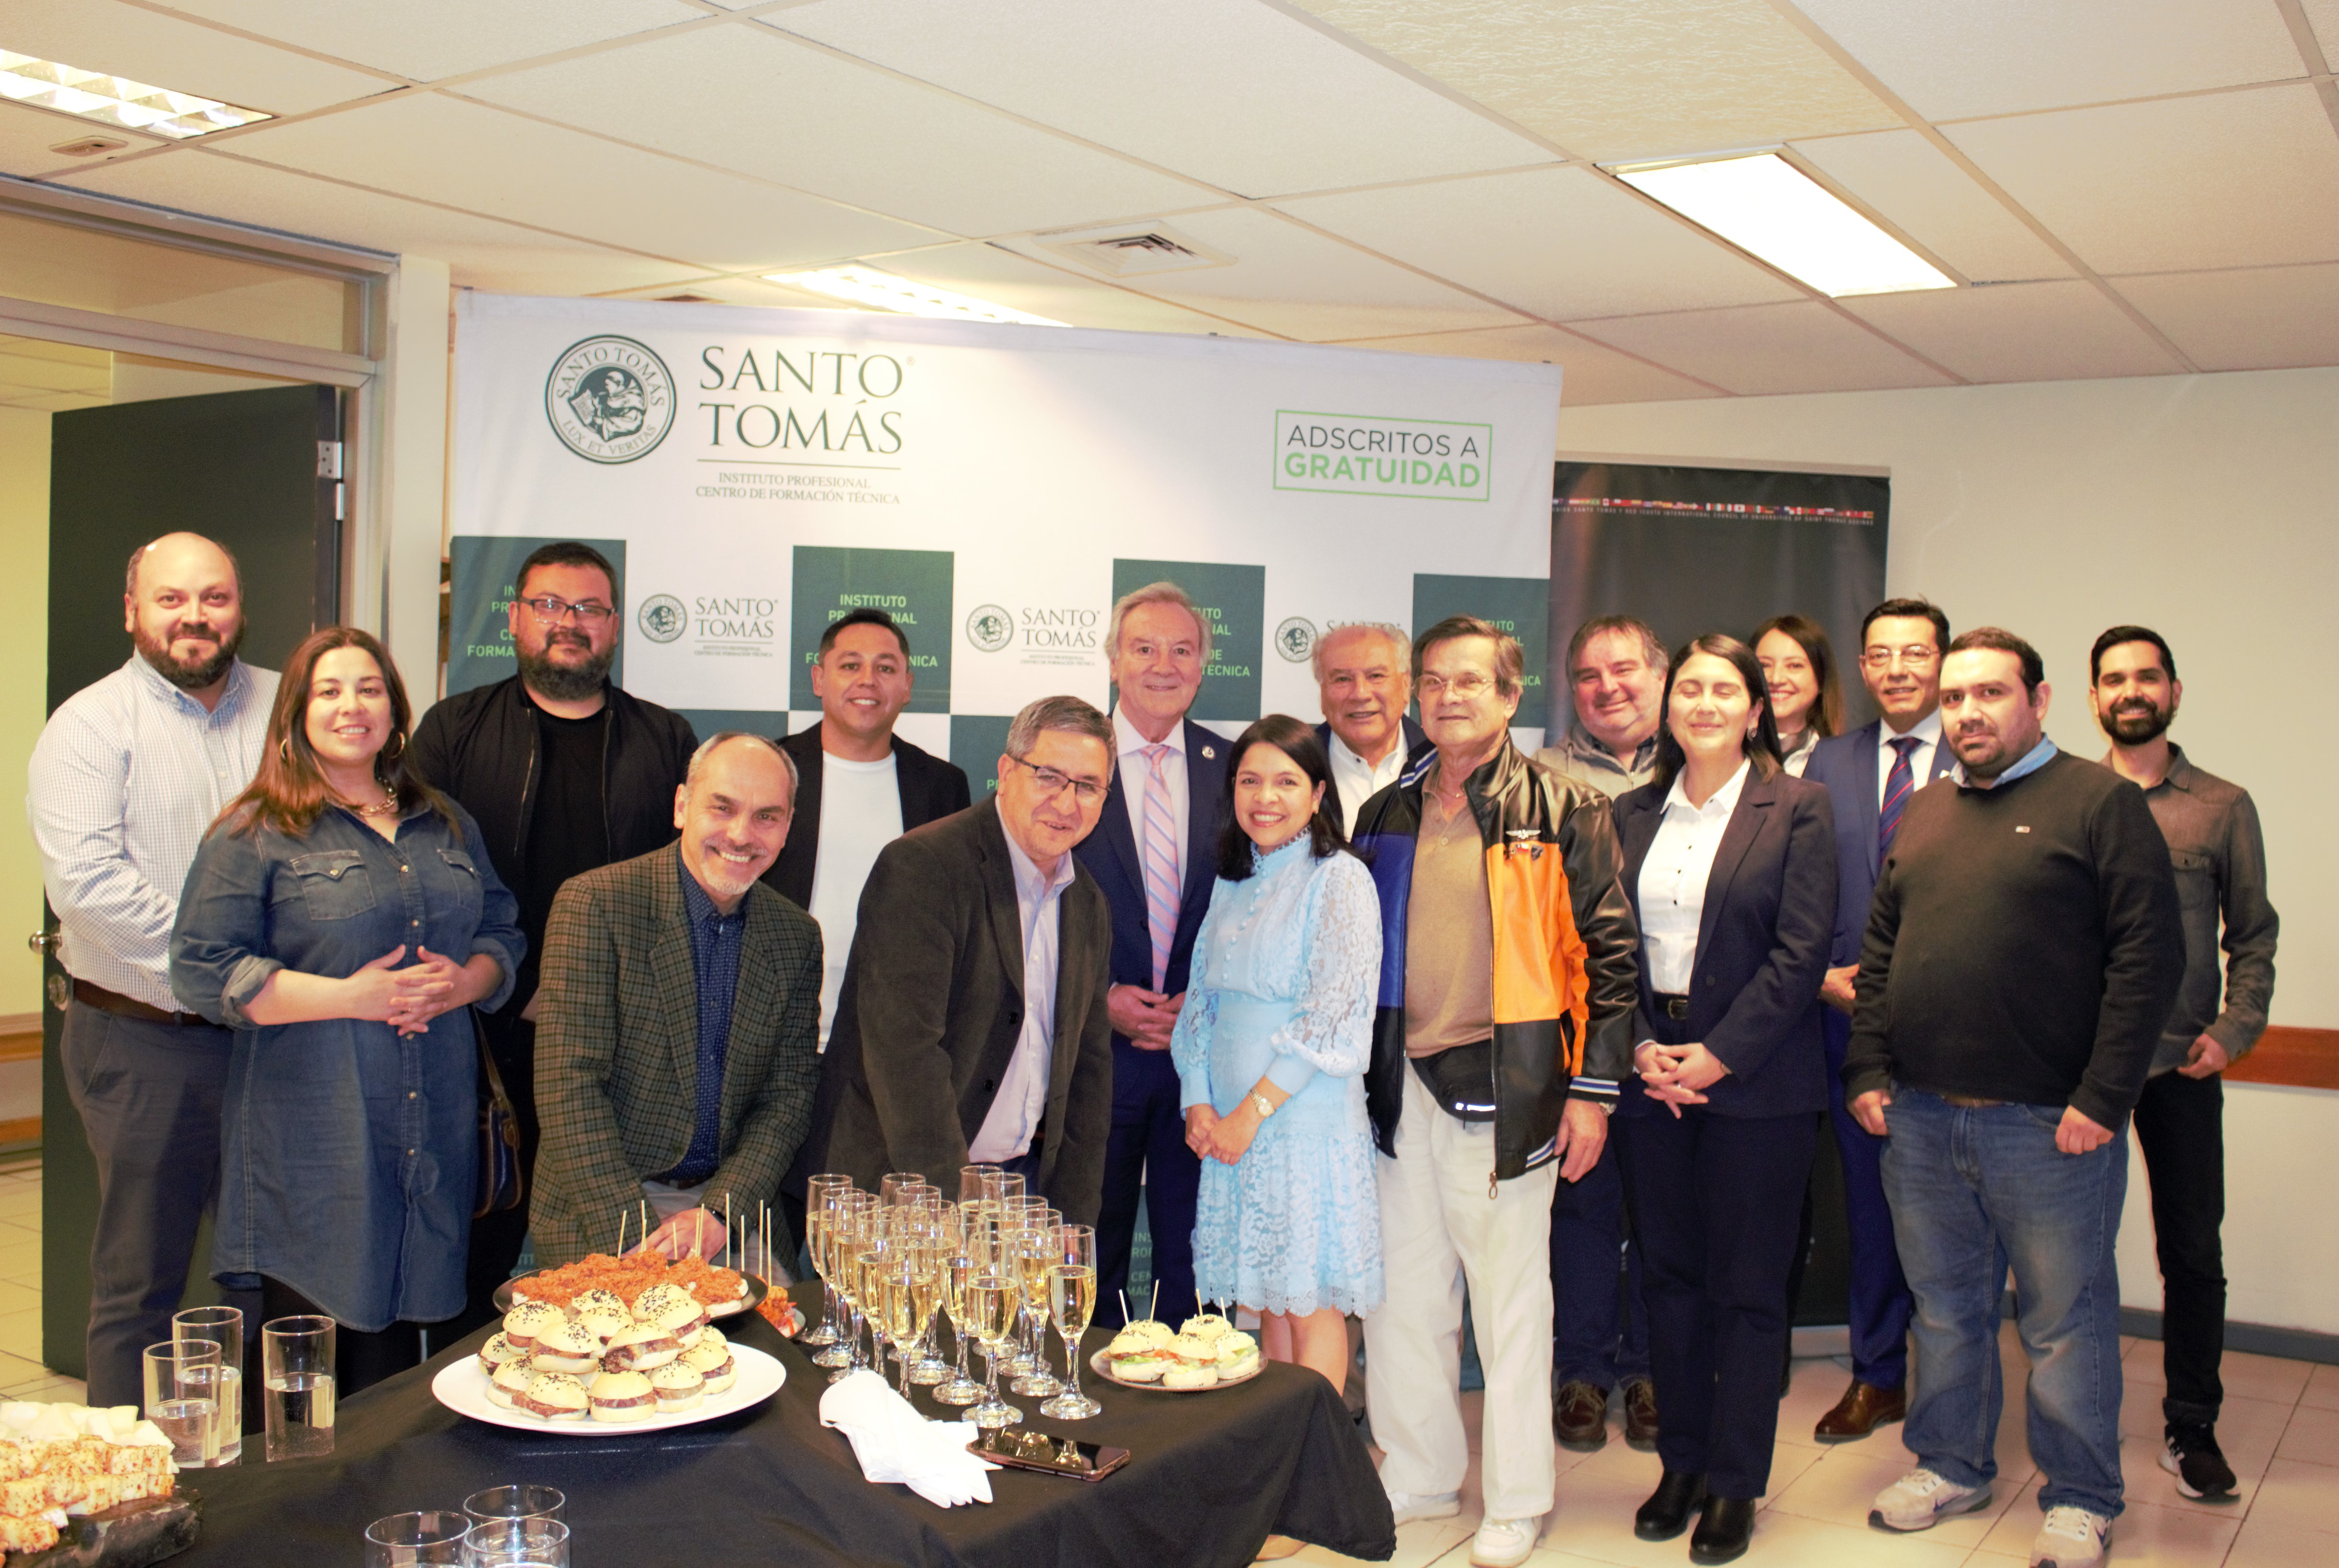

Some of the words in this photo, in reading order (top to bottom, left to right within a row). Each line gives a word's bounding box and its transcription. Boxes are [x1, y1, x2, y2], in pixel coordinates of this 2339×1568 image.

[556, 347, 608, 399] SANTO
[700, 346, 903, 398] SANTO
[698, 398, 902, 454] TOMÁS
[562, 420, 585, 444] LUX
[587, 440, 604, 454] ET
[609, 424, 658, 454] VERITAS
[1287, 424, 1451, 457] ADSCRITOS
[1460, 436, 1479, 458] A
[1284, 451, 1481, 488] GRATUIDAD
[719, 472, 784, 485] INSTITUTO
[787, 474, 871, 489] PROFESIONAL
[696, 485, 746, 498] CENTRO
[749, 487, 766, 498] DE
[769, 488, 845, 502] FORMACIÓN
[848, 490, 900, 504] TÉCNICA
[695, 597, 773, 617] SANTO
[840, 594, 907, 608] INSTITUTO
[695, 616, 773, 638] TOMÁS
[1022, 608, 1096, 627] SANTO
[1021, 627, 1096, 647] TOMÁS
[909, 655, 938, 667] NICA
